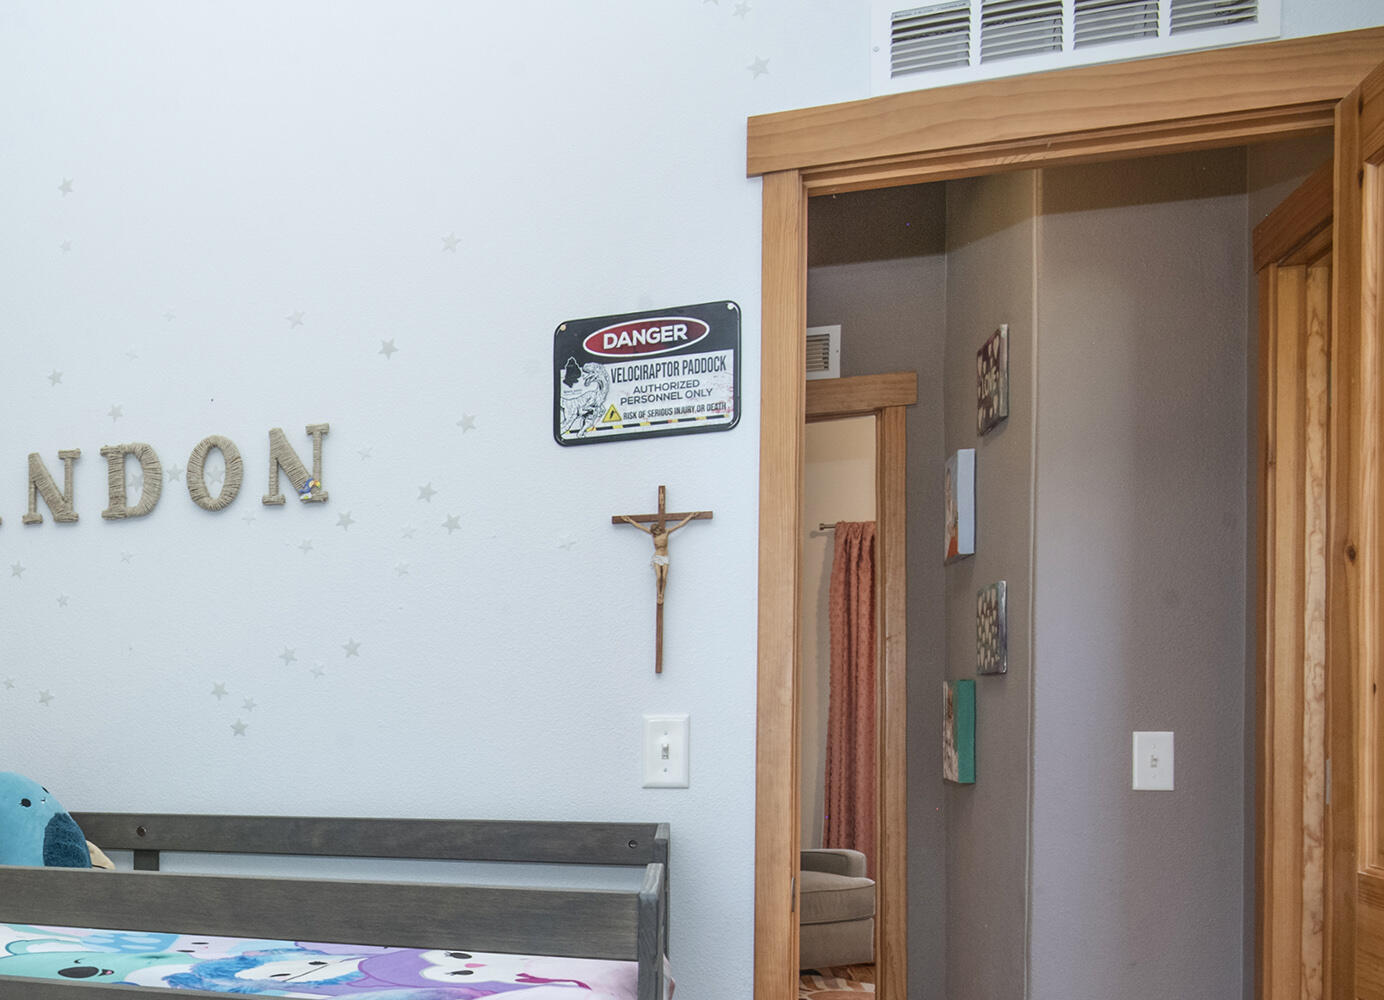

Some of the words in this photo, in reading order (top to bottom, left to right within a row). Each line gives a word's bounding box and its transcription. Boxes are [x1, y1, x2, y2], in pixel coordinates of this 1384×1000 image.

[603, 323, 688, 350] DANGER
[610, 360, 680, 384] VELOCIRAPTOR
[682, 355, 727, 376] PADDOCK
[633, 379, 700, 394] AUTHORIZED
[620, 392, 683, 406] PERSONNEL
[685, 388, 713, 400] ONLY
[623, 411, 637, 420] RISK
[638, 410, 647, 418] OF
[647, 408, 673, 418] SERIOUS
[696, 404, 705, 412] OR
[706, 402, 727, 411] DEATH
